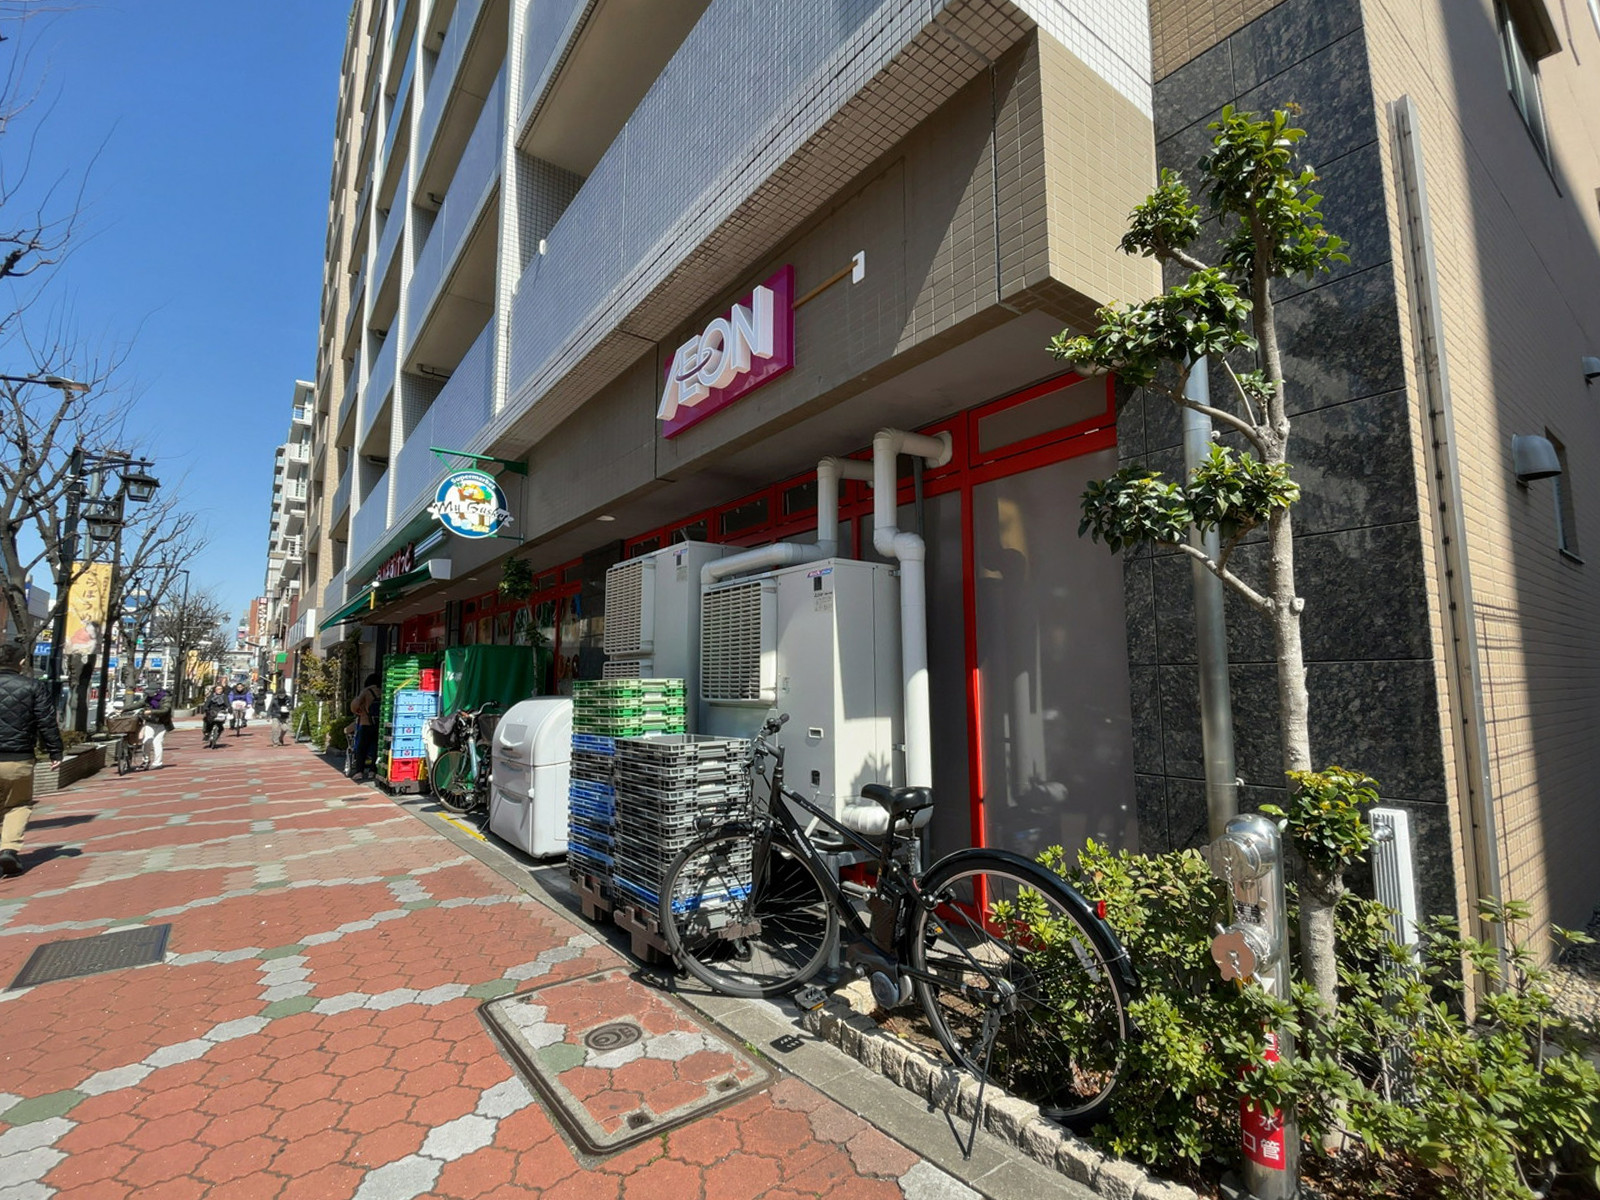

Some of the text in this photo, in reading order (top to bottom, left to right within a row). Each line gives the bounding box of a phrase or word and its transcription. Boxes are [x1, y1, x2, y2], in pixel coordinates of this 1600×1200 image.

[656, 285, 774, 421] AEON
[450, 475, 496, 489] Supermarket
[432, 501, 461, 514] My
